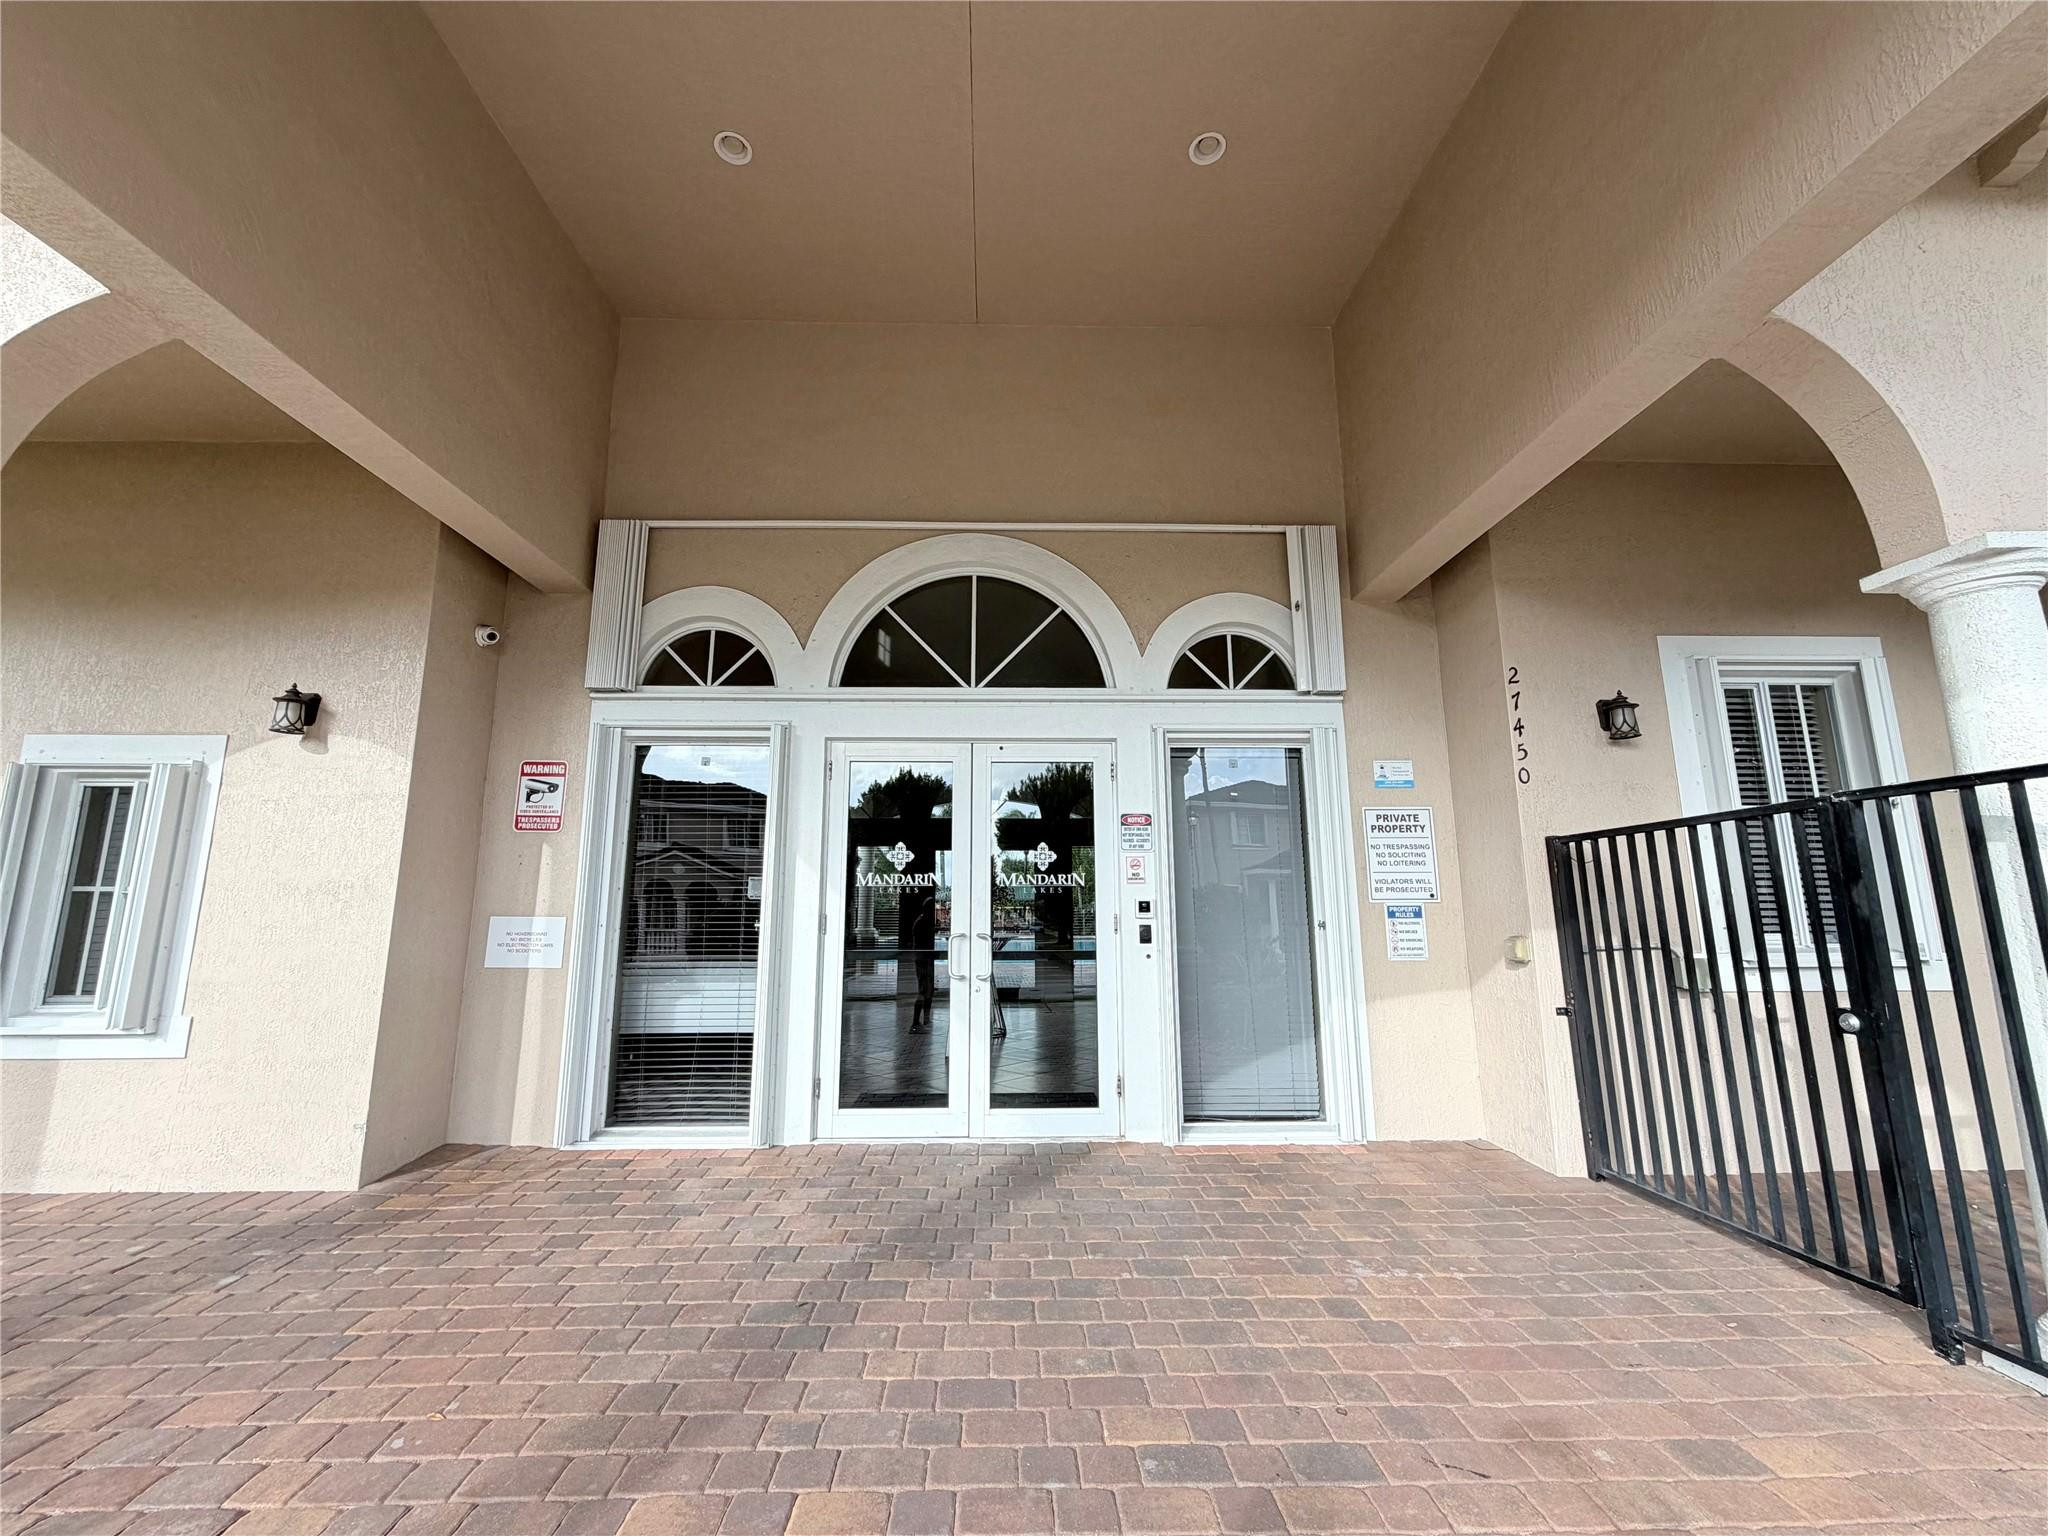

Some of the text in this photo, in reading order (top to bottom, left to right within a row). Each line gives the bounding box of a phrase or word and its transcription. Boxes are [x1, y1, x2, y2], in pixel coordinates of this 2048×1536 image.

[1508, 667, 1531, 784] 27450
[523, 764, 566, 774] WARNING
[1127, 816, 1145, 824] NOTICE
[1375, 813, 1420, 823] PRIVATE
[1370, 824, 1426, 833] PROPERTY
[856, 872, 943, 887] MANDARIN
[1000, 872, 1086, 887] MANDARIN
